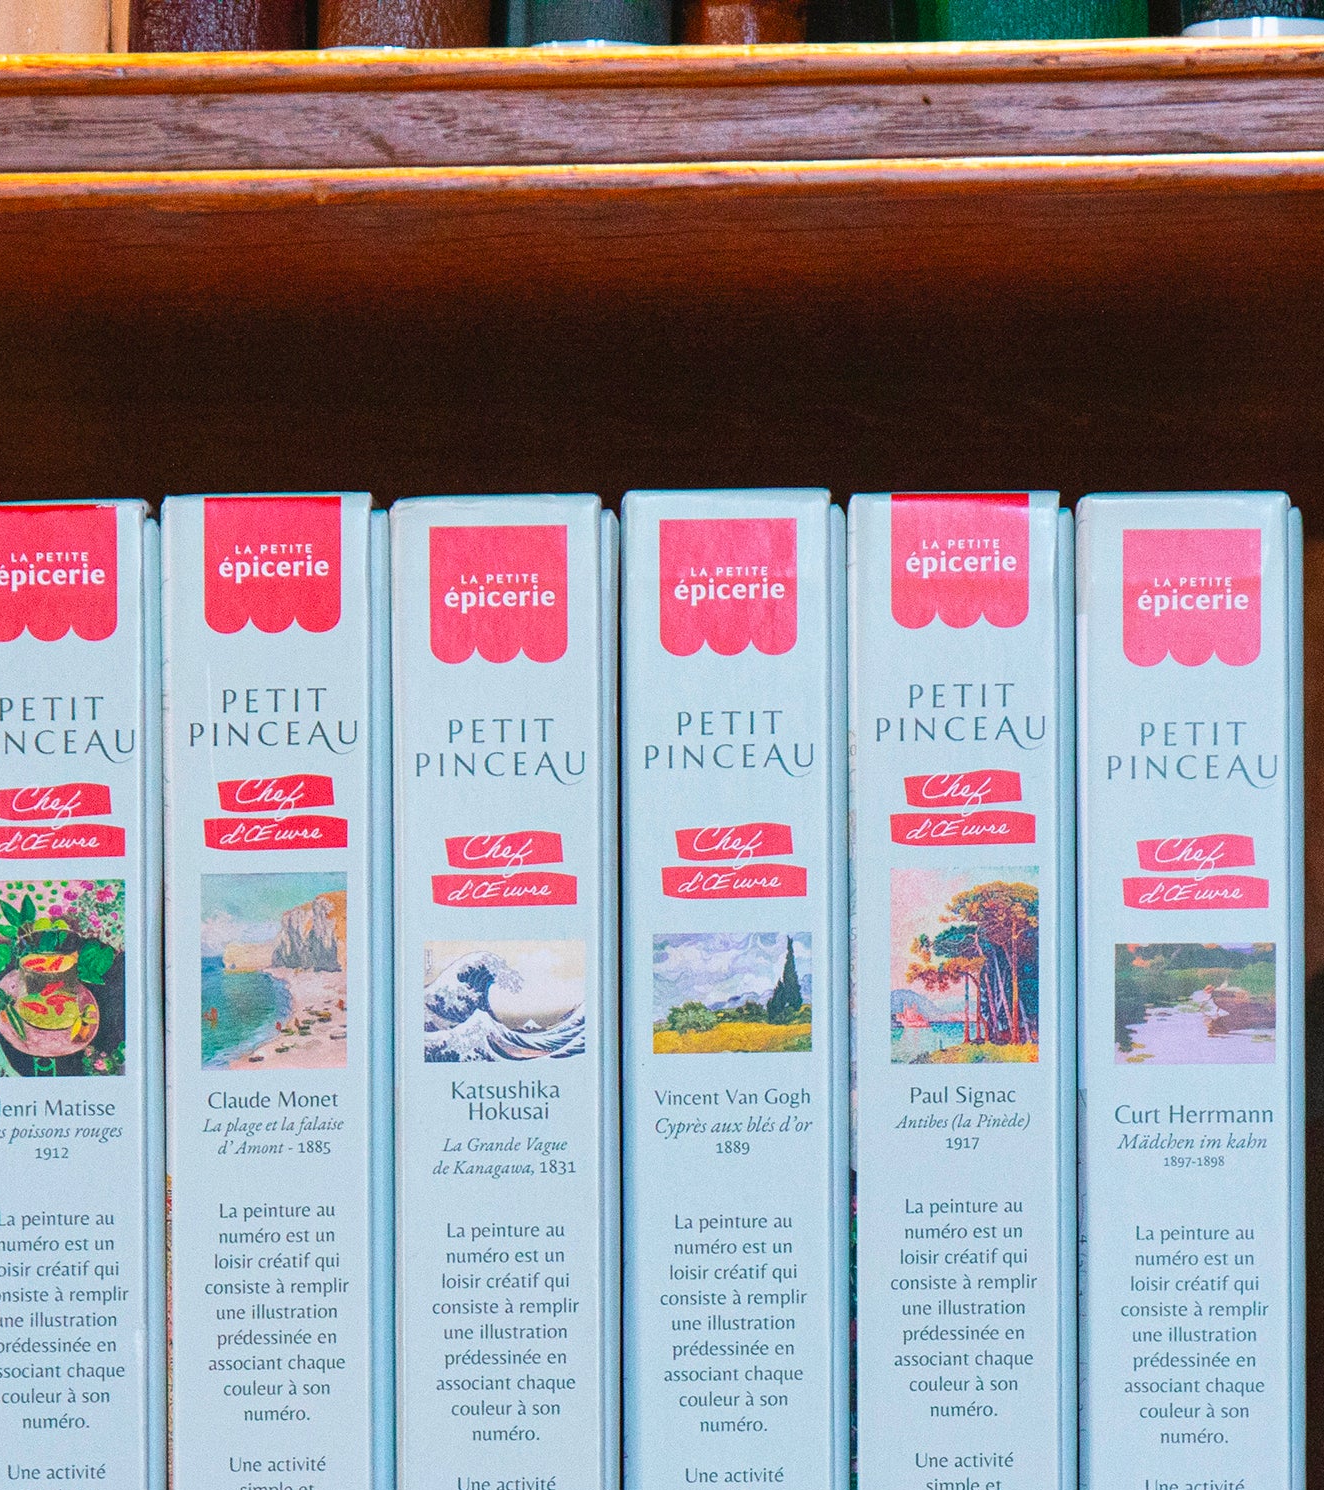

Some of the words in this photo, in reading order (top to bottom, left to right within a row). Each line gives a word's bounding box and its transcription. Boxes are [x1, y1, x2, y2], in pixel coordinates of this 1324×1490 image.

[10, 551, 29, 563] LA
[35, 551, 89, 563] PETITE
[221, 687, 328, 714] PETIT
[188, 719, 359, 756] PINCEAU
[462, 832, 534, 879] Chef
[206, 1090, 272, 1110] Claude
[277, 1090, 338, 1109] Monet
[451, 1079, 560, 1100] Katsushika
[654, 1090, 720, 1106] Vincent
[724, 1088, 759, 1106] Van
[763, 1087, 812, 1110] Gogh
[909, 1085, 949, 1105] Paul
[955, 1085, 1016, 1109] Signac
[44, 1098, 116, 1117] Matisse
[468, 1100, 550, 1122] Hokusai
[1113, 1104, 1160, 1125] Curt
[1168, 1104, 1274, 1125] Herrmann
[202, 1117, 223, 1133] La
[223, 1116, 263, 1138] plage
[264, 1120, 279, 1132] et
[281, 1116, 294, 1132] la
[297, 1115, 346, 1138] falaise
[654, 1117, 707, 1140] Cyprès
[709, 1121, 744, 1134] aux
[746, 1115, 775, 1133] blés
[778, 1114, 814, 1133] d'or
[894, 1113, 949, 1130] Antibes
[950, 1113, 972, 1131] (la
[976, 1112, 1031, 1130] Pinède)
[7, 1126, 71, 1145] poissons
[74, 1126, 123, 1144] rouges
[945, 1136, 980, 1151] 1917
[1116, 1132, 1195, 1150] Mädchen
[1199, 1138, 1222, 1150] im
[1225, 1132, 1267, 1150] kahn
[35, 1146, 70, 1161] 1912
[218, 1139, 286, 1157] d'Amont
[298, 1139, 334, 1157] 1885
[442, 1137, 463, 1153] La
[466, 1136, 522, 1152] Grande
[526, 1136, 568, 1157] Vague
[715, 1139, 751, 1156] 1889
[431, 1159, 450, 1176] de
[452, 1159, 535, 1180] Kanagawa,
[539, 1158, 576, 1176] 1831
[1164, 1155, 1225, 1169] 1897-1898
[54, 1286, 64, 1303] à
[69, 1285, 130, 1306] remplir
